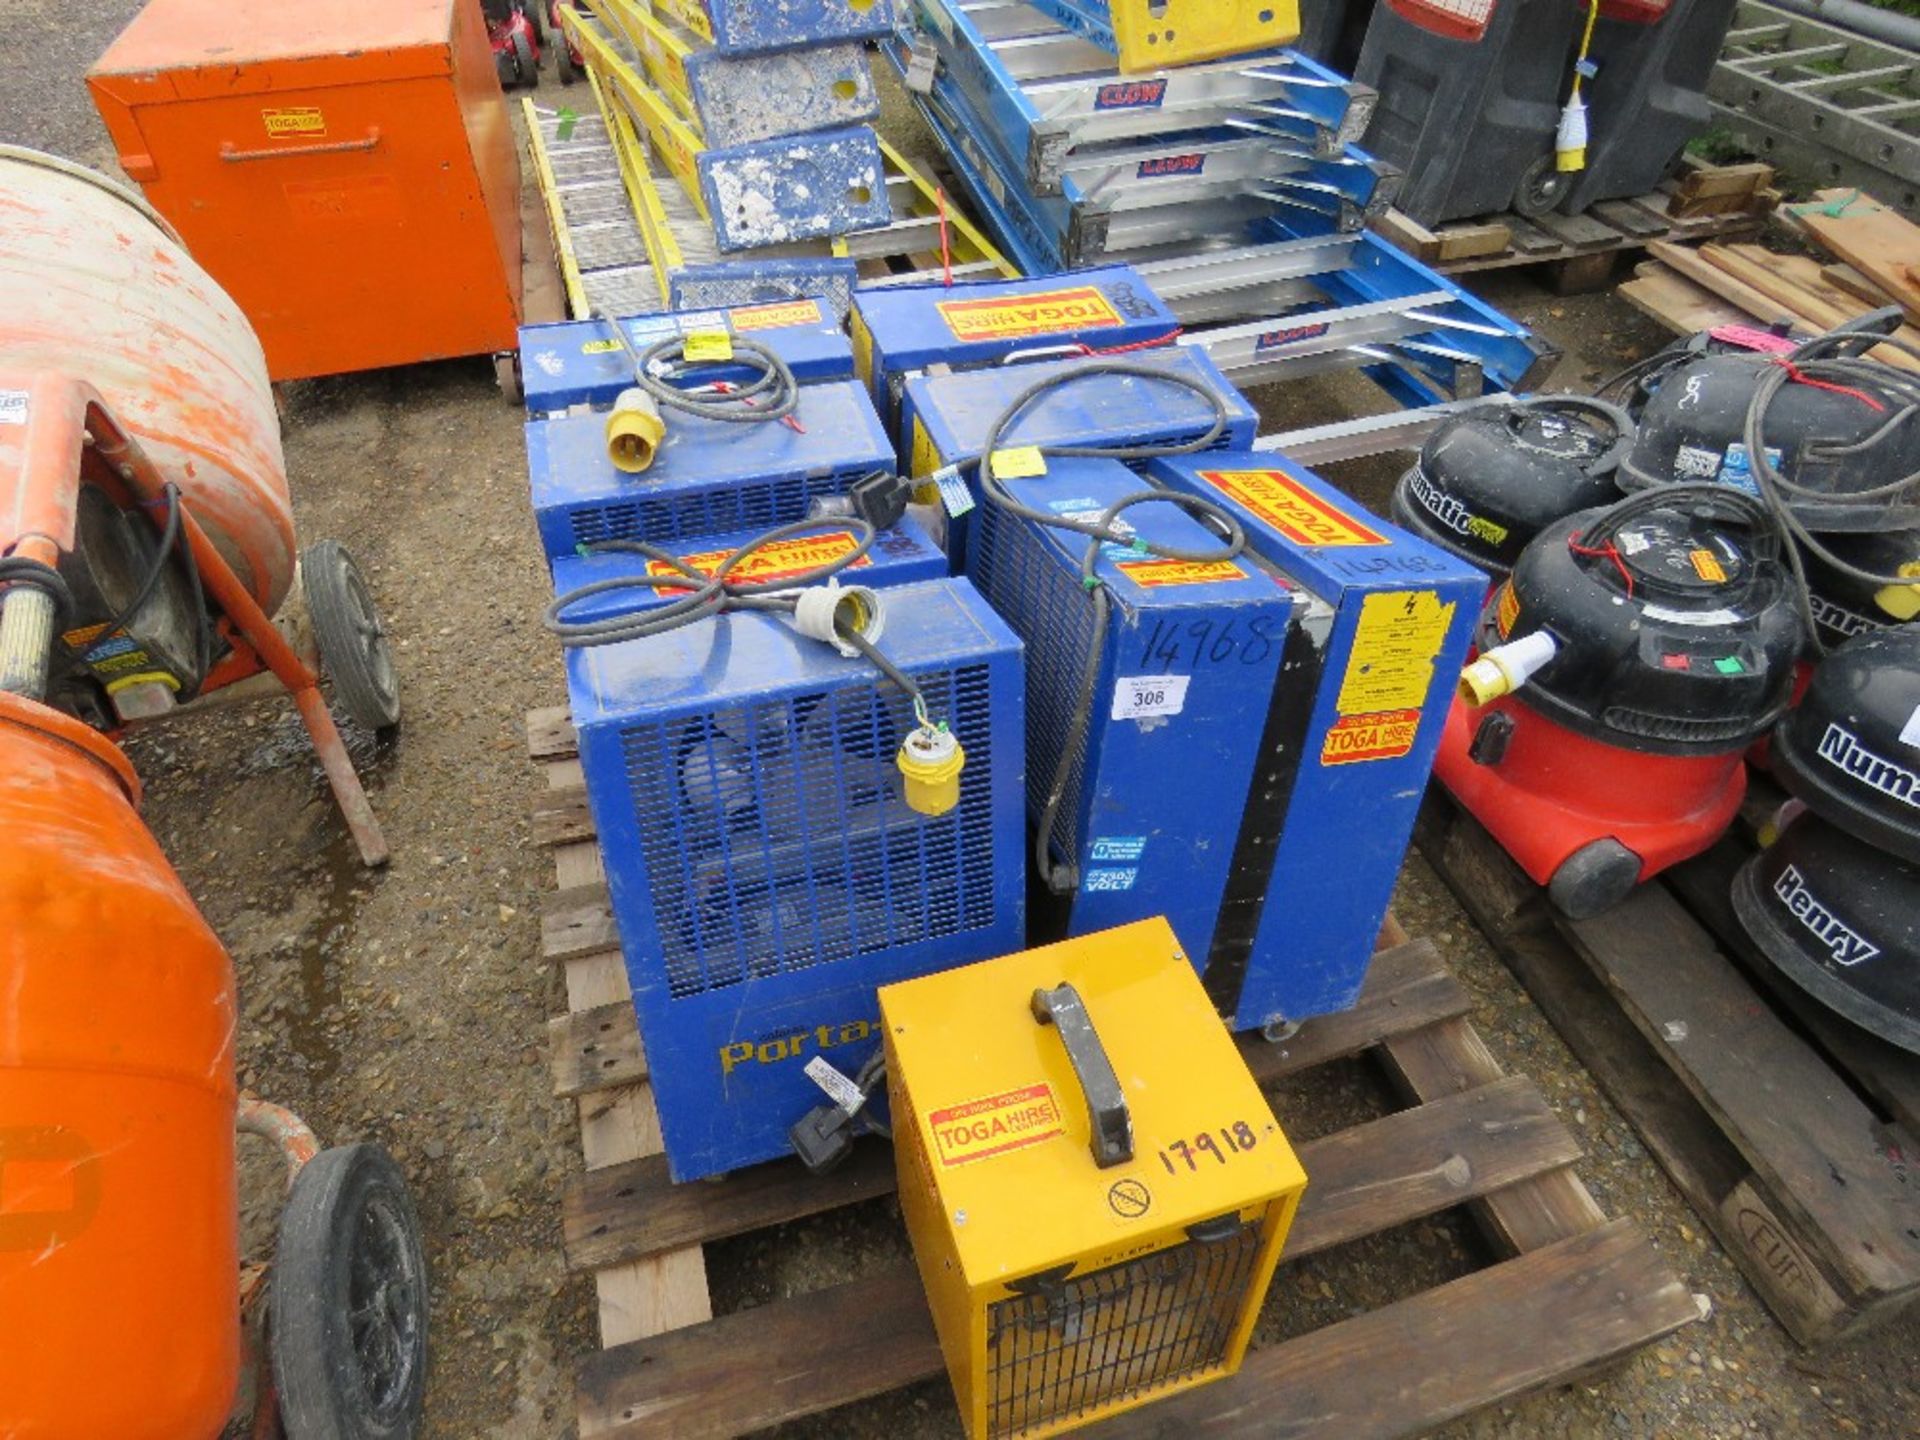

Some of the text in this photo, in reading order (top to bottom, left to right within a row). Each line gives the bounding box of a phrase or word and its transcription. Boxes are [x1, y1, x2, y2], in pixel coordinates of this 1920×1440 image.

[1101, 82, 1162, 105] CLOW
[1018, 302, 1105, 321] TOGA
[1275, 500, 1347, 544] TOGA
[1140, 614, 1274, 672] 14968
[1329, 728, 1378, 751] TOGA
[1774, 864, 1881, 967] Henry
[940, 1103, 1052, 1149] TOGA HIRE
[1158, 1120, 1256, 1175] 17918
